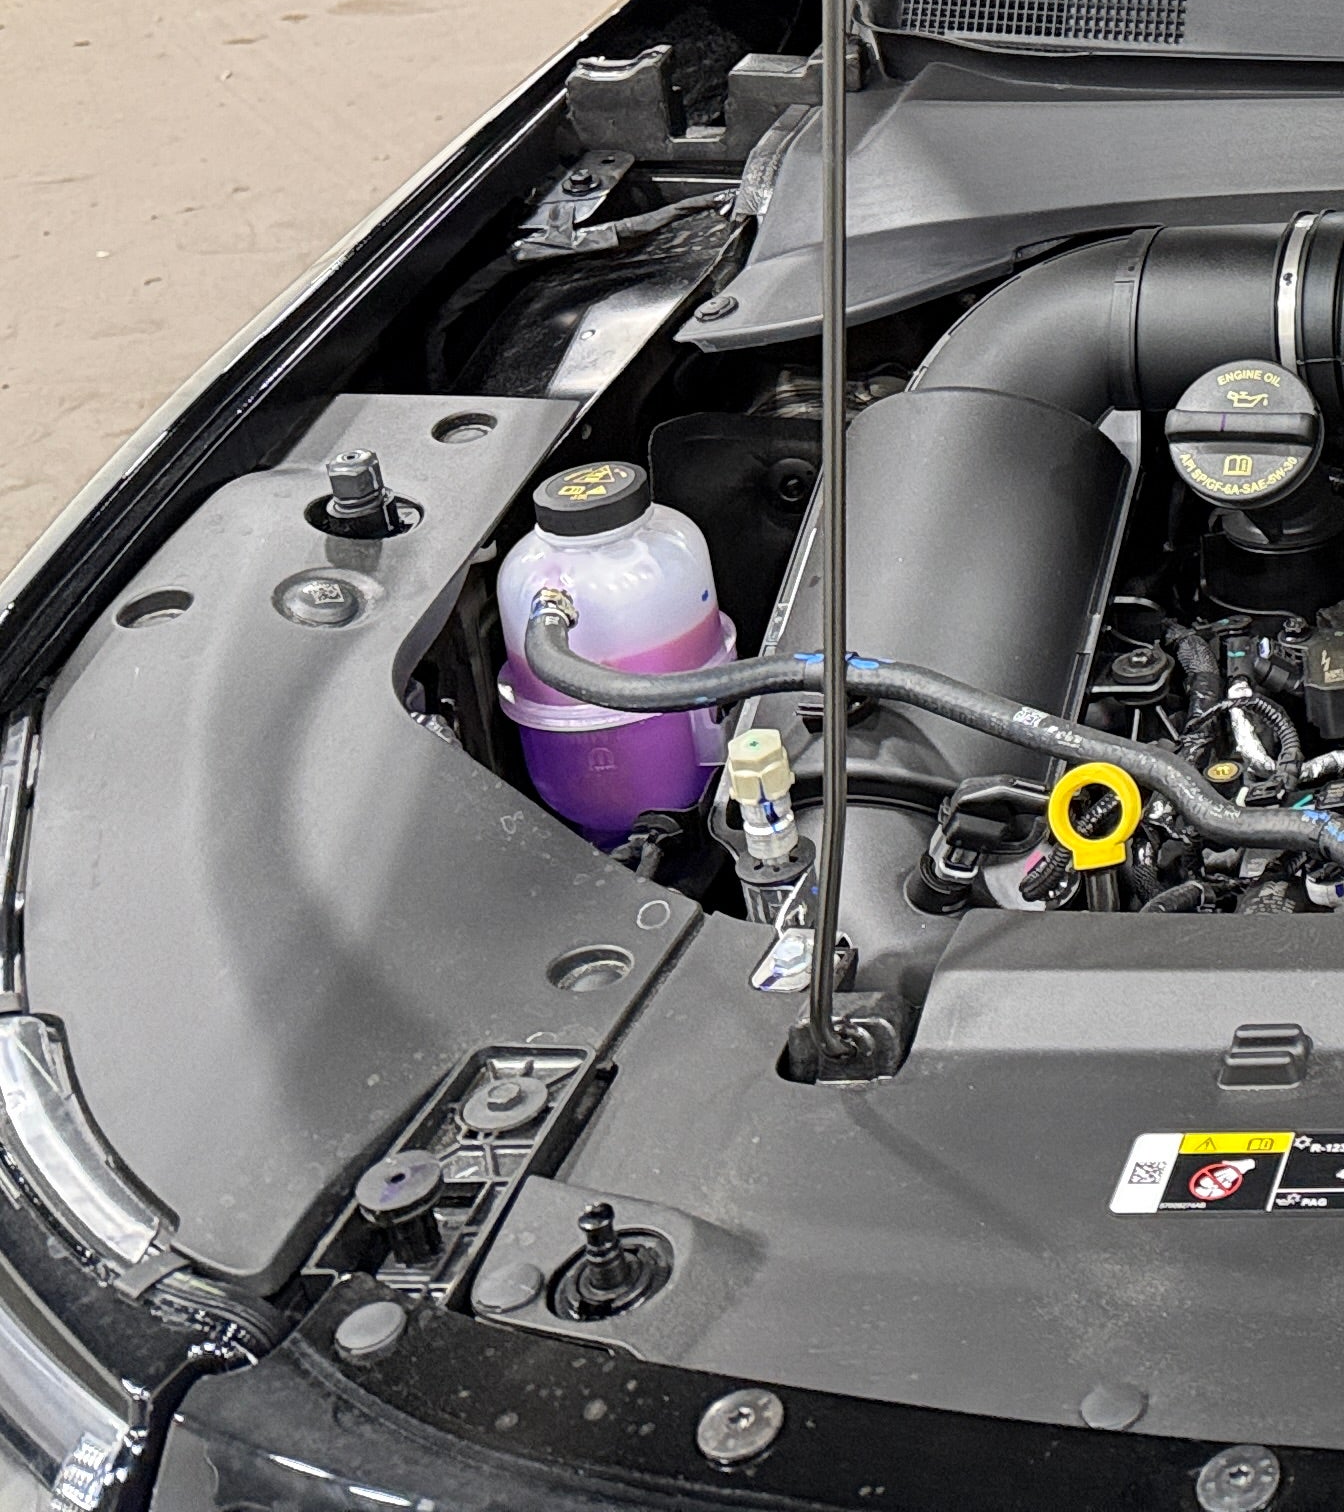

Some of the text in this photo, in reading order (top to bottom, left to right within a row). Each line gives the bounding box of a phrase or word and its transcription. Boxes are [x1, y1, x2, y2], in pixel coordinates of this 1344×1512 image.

[1216, 369, 1282, 388] ENGINE OIL
[1300, 1197, 1328, 1207] PAG
